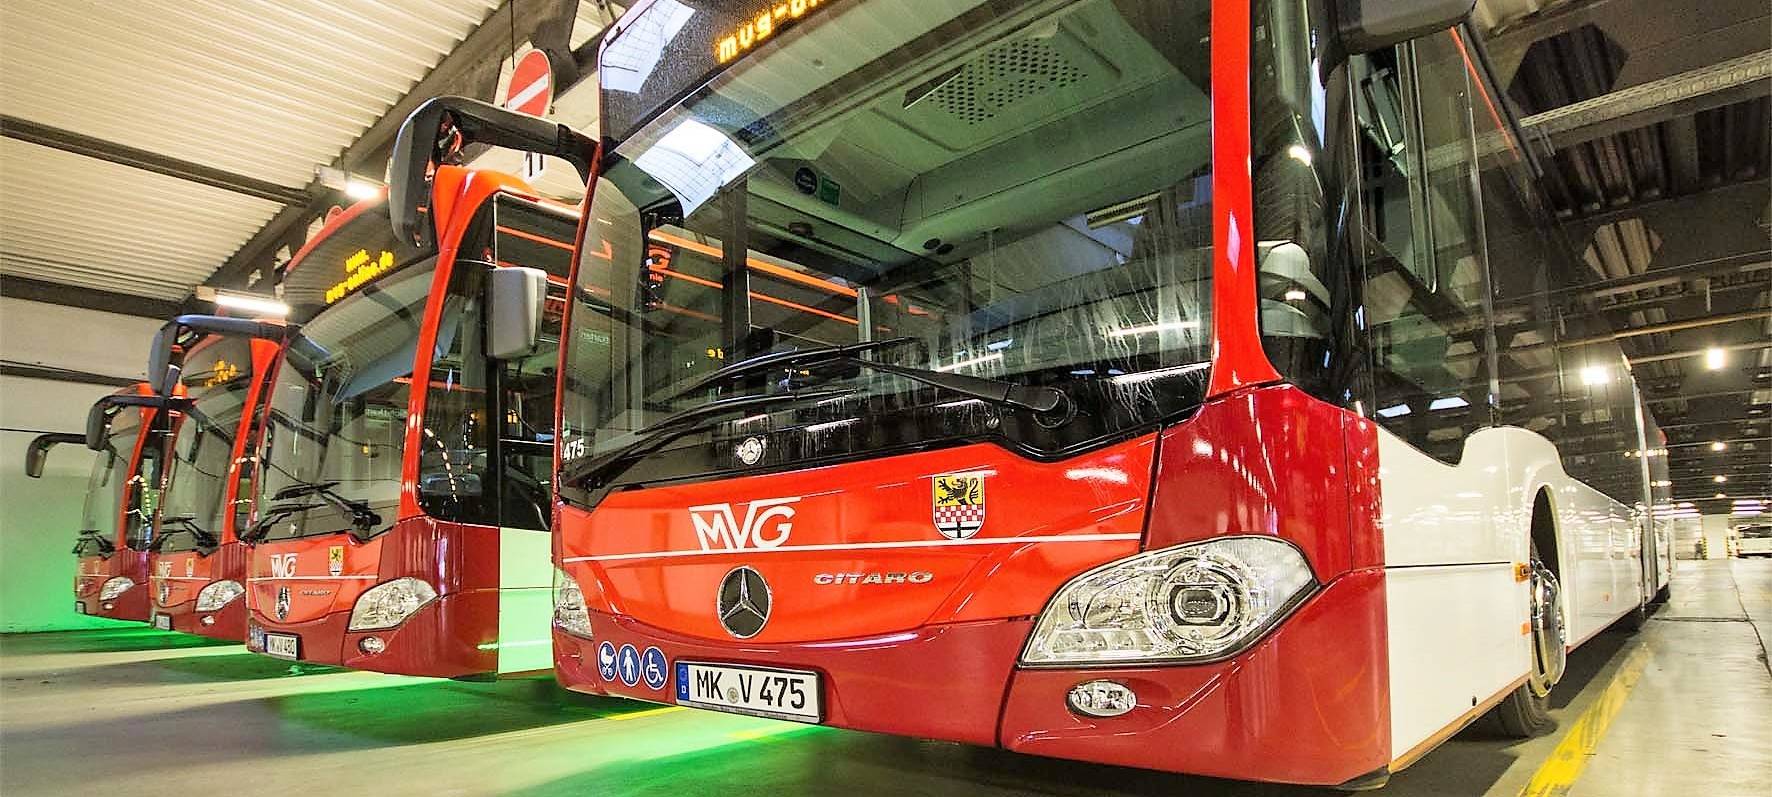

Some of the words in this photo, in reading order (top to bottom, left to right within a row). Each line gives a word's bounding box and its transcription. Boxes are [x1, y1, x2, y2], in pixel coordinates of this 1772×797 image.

[718, 0, 825, 64] mvg-o
[563, 438, 585, 461] 475
[688, 496, 801, 552] MVG
[270, 553, 299, 578] MVG
[813, 571, 934, 586] CITARO
[696, 669, 724, 700] MK
[738, 673, 753, 703] V
[759, 676, 806, 709] 475
